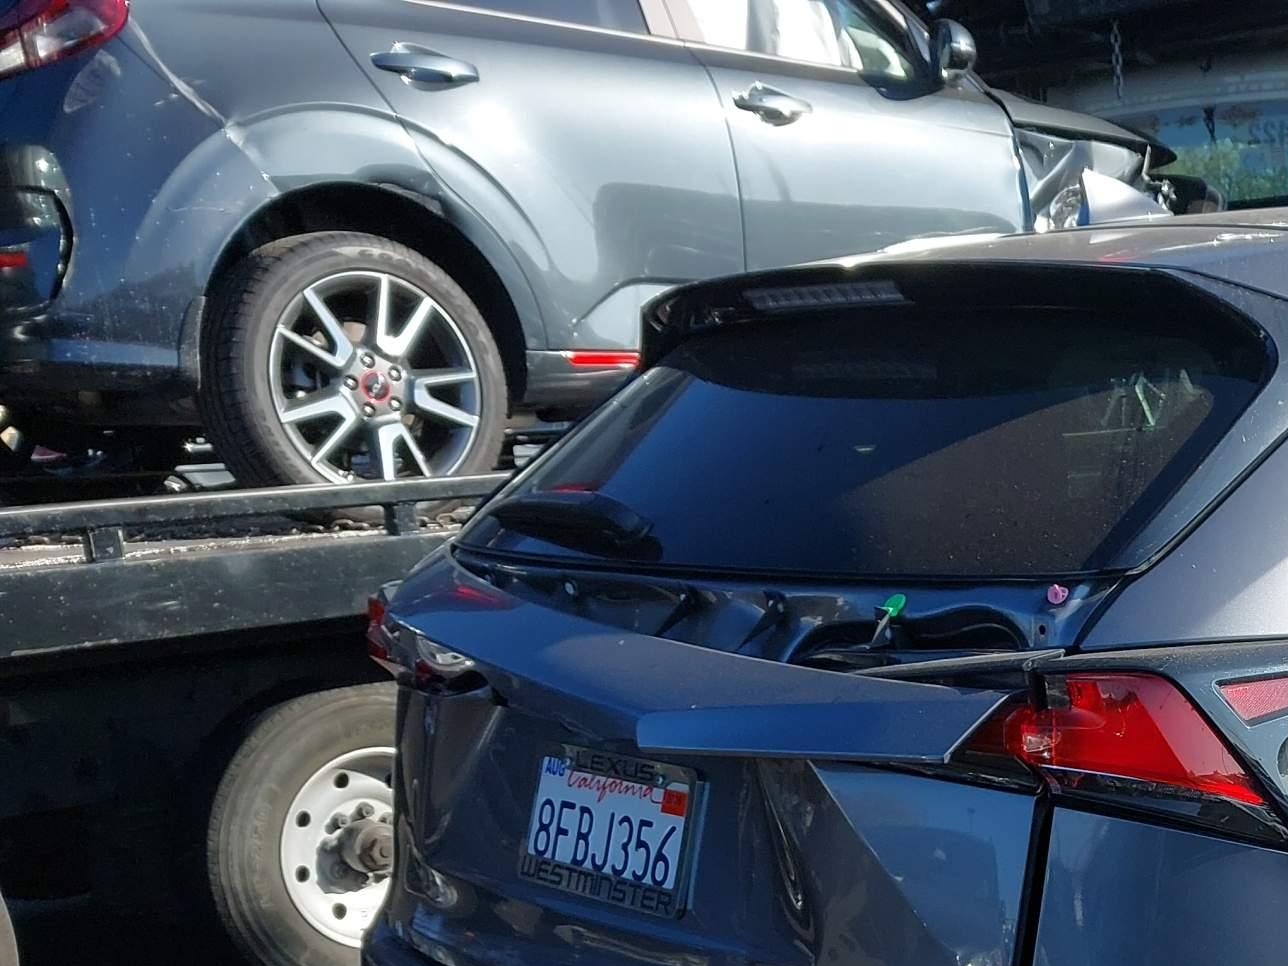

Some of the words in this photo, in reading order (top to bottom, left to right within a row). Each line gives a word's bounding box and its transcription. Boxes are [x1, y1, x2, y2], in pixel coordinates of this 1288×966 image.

[568, 770, 653, 802] California
[575, 752, 656, 781] LEXUS
[533, 798, 677, 887] 8FBJ356
[521, 855, 674, 915] WESTMINSTER
